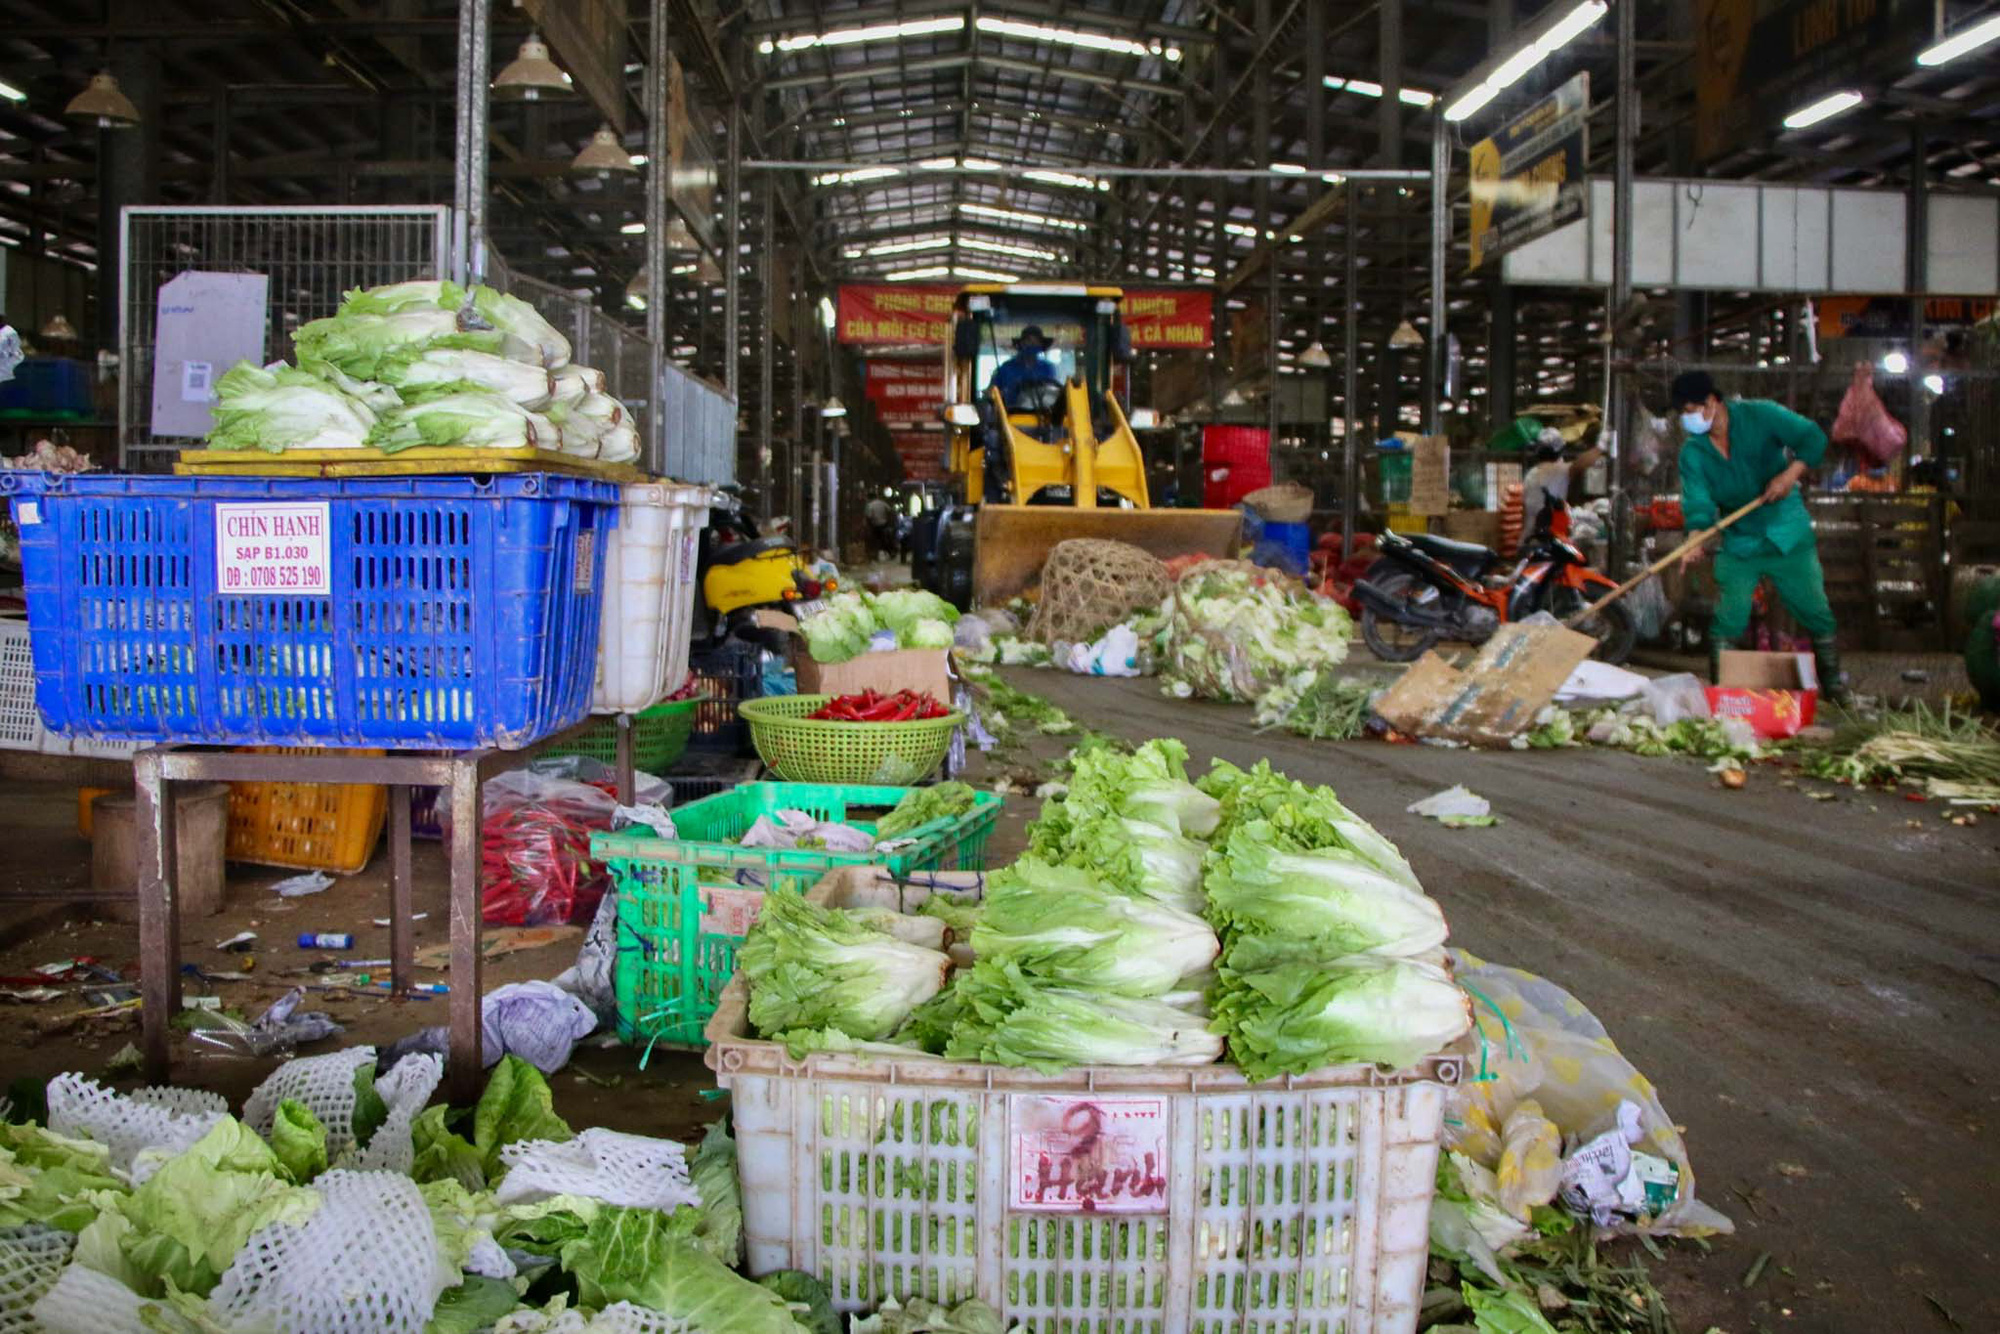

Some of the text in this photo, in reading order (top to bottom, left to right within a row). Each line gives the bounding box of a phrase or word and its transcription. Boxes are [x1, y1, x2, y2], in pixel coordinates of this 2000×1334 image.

[1165, 322, 1204, 343] NHÂN
[273, 515, 320, 542] HẠNH
[236, 546, 308, 563] SẠP B1.030
[251, 566, 276, 586] 0708
[280, 566, 298, 585] 525
[302, 566, 320, 585] 190
